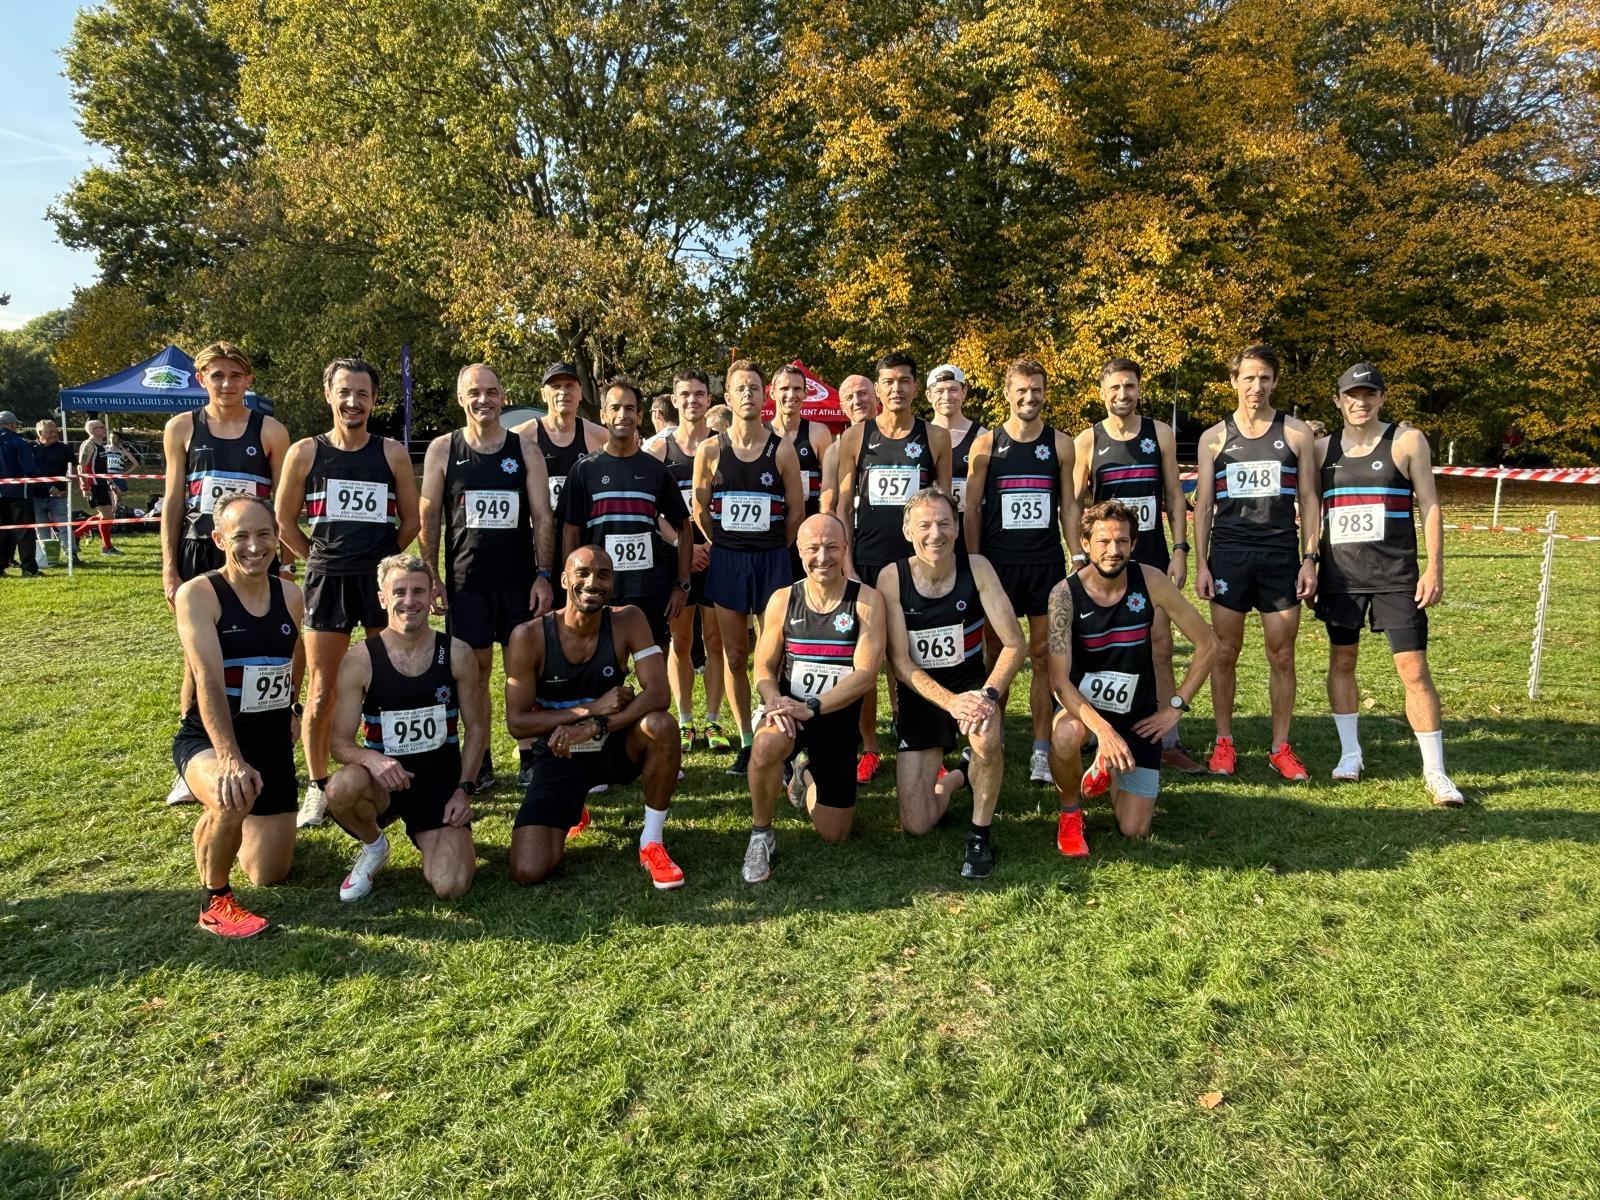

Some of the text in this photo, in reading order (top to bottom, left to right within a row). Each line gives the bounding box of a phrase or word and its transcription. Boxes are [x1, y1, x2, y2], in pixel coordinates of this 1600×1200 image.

[72, 396, 126, 405] DARTFORD
[128, 396, 174, 406] HARRIERS
[878, 477, 912, 496] 957
[1236, 469, 1271, 489] 948
[338, 489, 377, 512] 956
[475, 499, 510, 520] 949
[1011, 501, 1043, 520] 935
[730, 503, 762, 523] 979
[1338, 513, 1374, 534] 983
[614, 541, 647, 562] 982
[437, 645, 445, 665] soar
[917, 635, 956, 660] 963
[256, 672, 291, 701] 959
[1090, 678, 1128, 704] 966
[393, 717, 437, 744] 950
